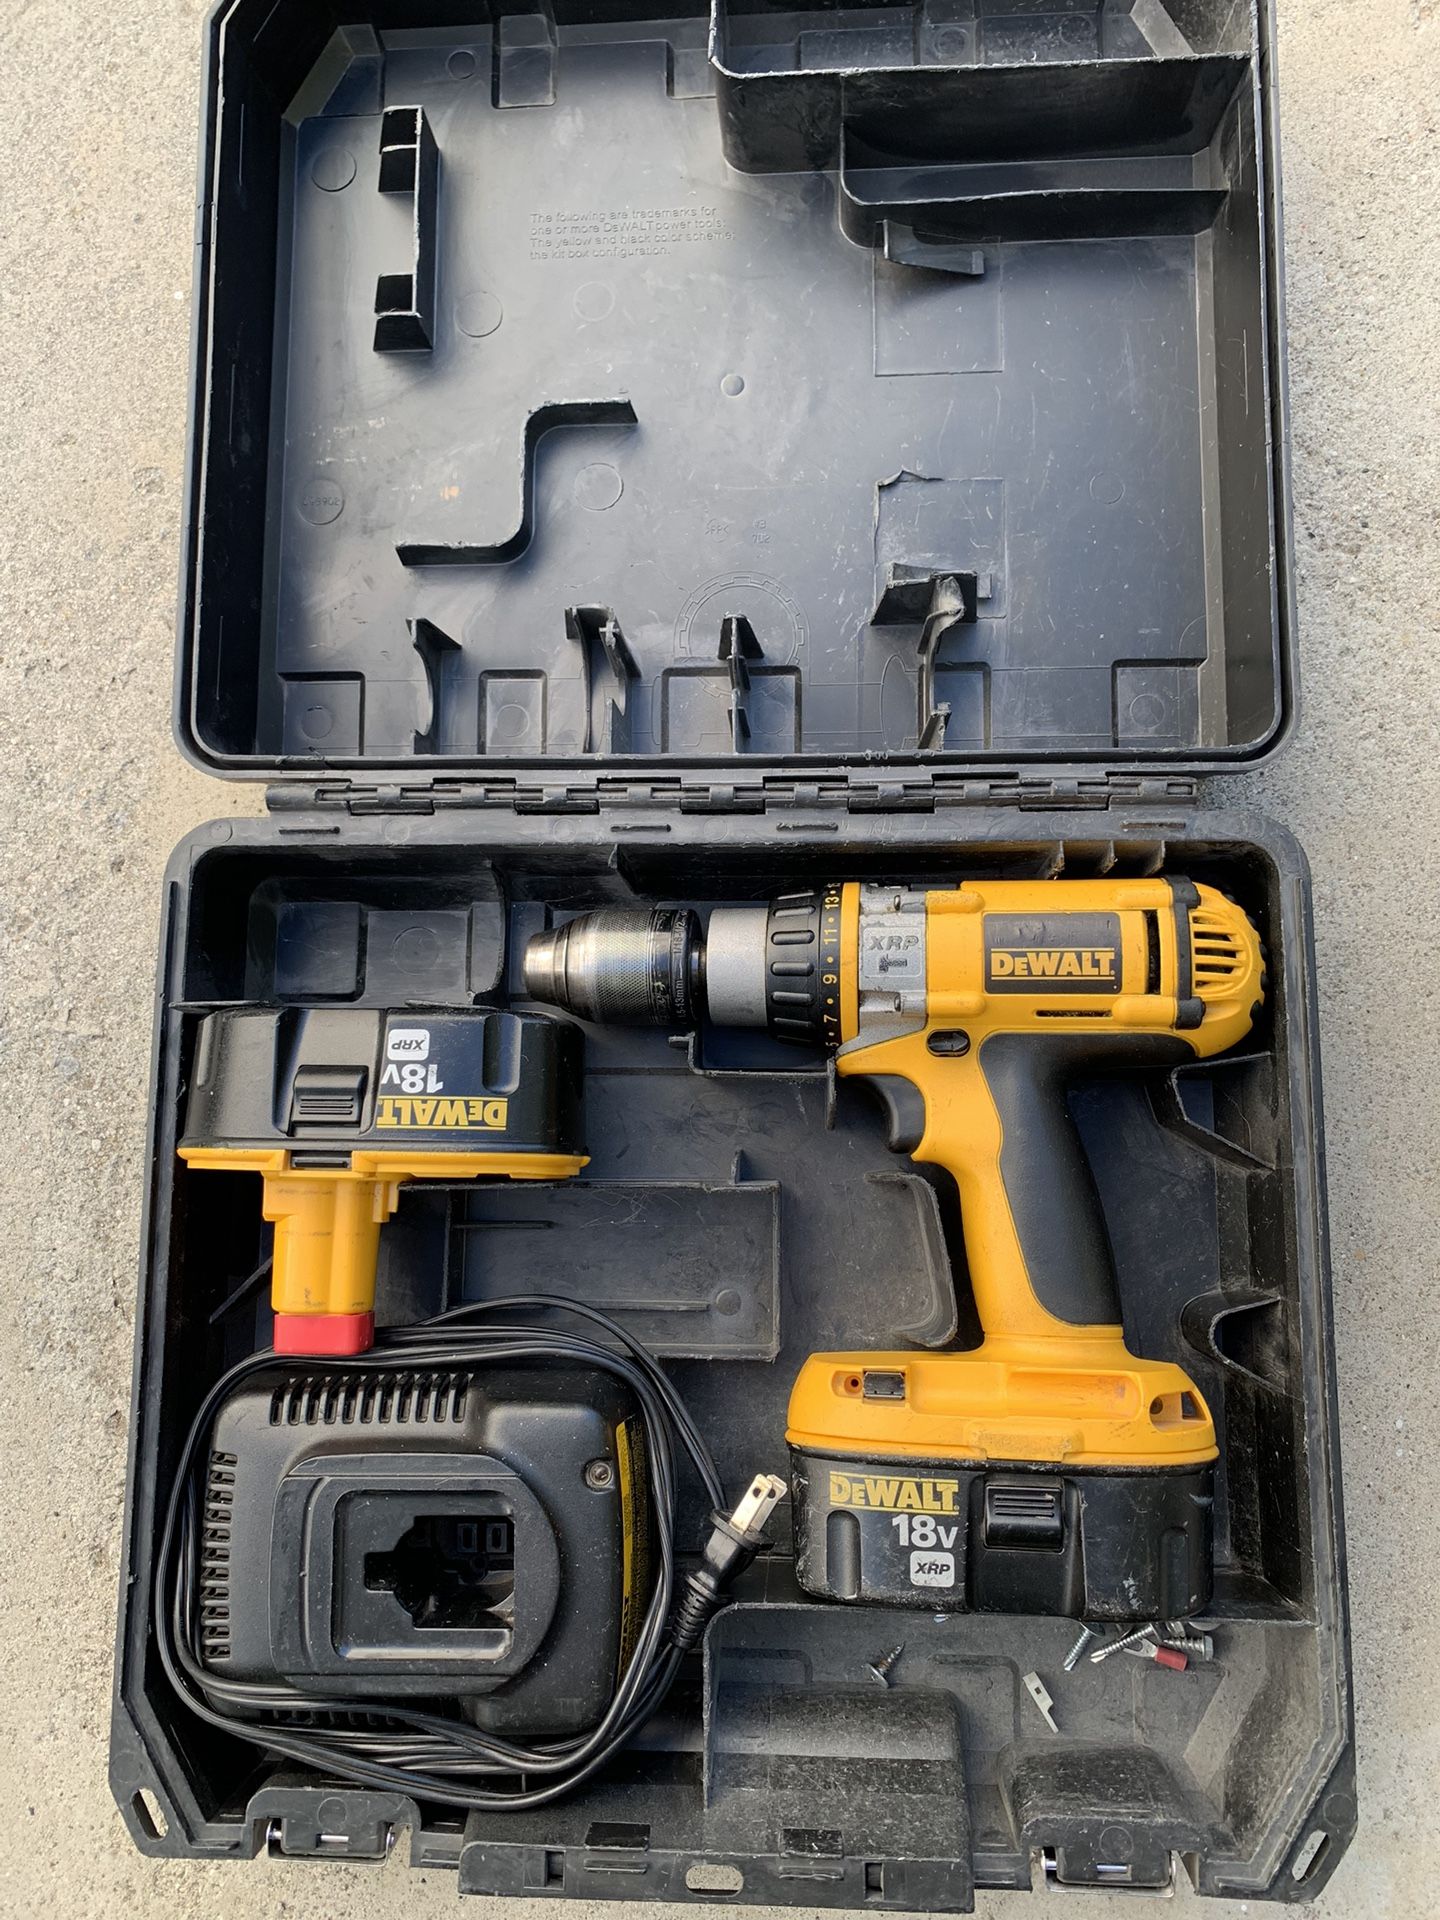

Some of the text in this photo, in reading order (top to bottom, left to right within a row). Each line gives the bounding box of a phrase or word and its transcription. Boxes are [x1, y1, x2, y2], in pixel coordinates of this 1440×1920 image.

[530, 206, 716, 224] The following are trademarks for
[530, 227, 551, 236] one
[556, 226, 567, 235] or
[570, 224, 600, 234] more
[655, 221, 691, 231] power
[530, 237, 552, 247] The
[555, 236, 591, 249] yellow
[595, 235, 617, 245] and
[620, 233, 650, 244] black
[654, 232, 682, 242] color
[530, 250, 548, 260] the
[552, 249, 565, 259] kit
[568, 248, 589, 259] box
[824, 896, 840, 910] 13
[823, 928, 838, 945] 11
[867, 935, 920, 951] XRP
[823, 973, 838, 984] 9
[823, 1014, 838, 1023] 7
[391, 1039, 426, 1051] XRP
[914, 1562, 951, 1575] XRP
